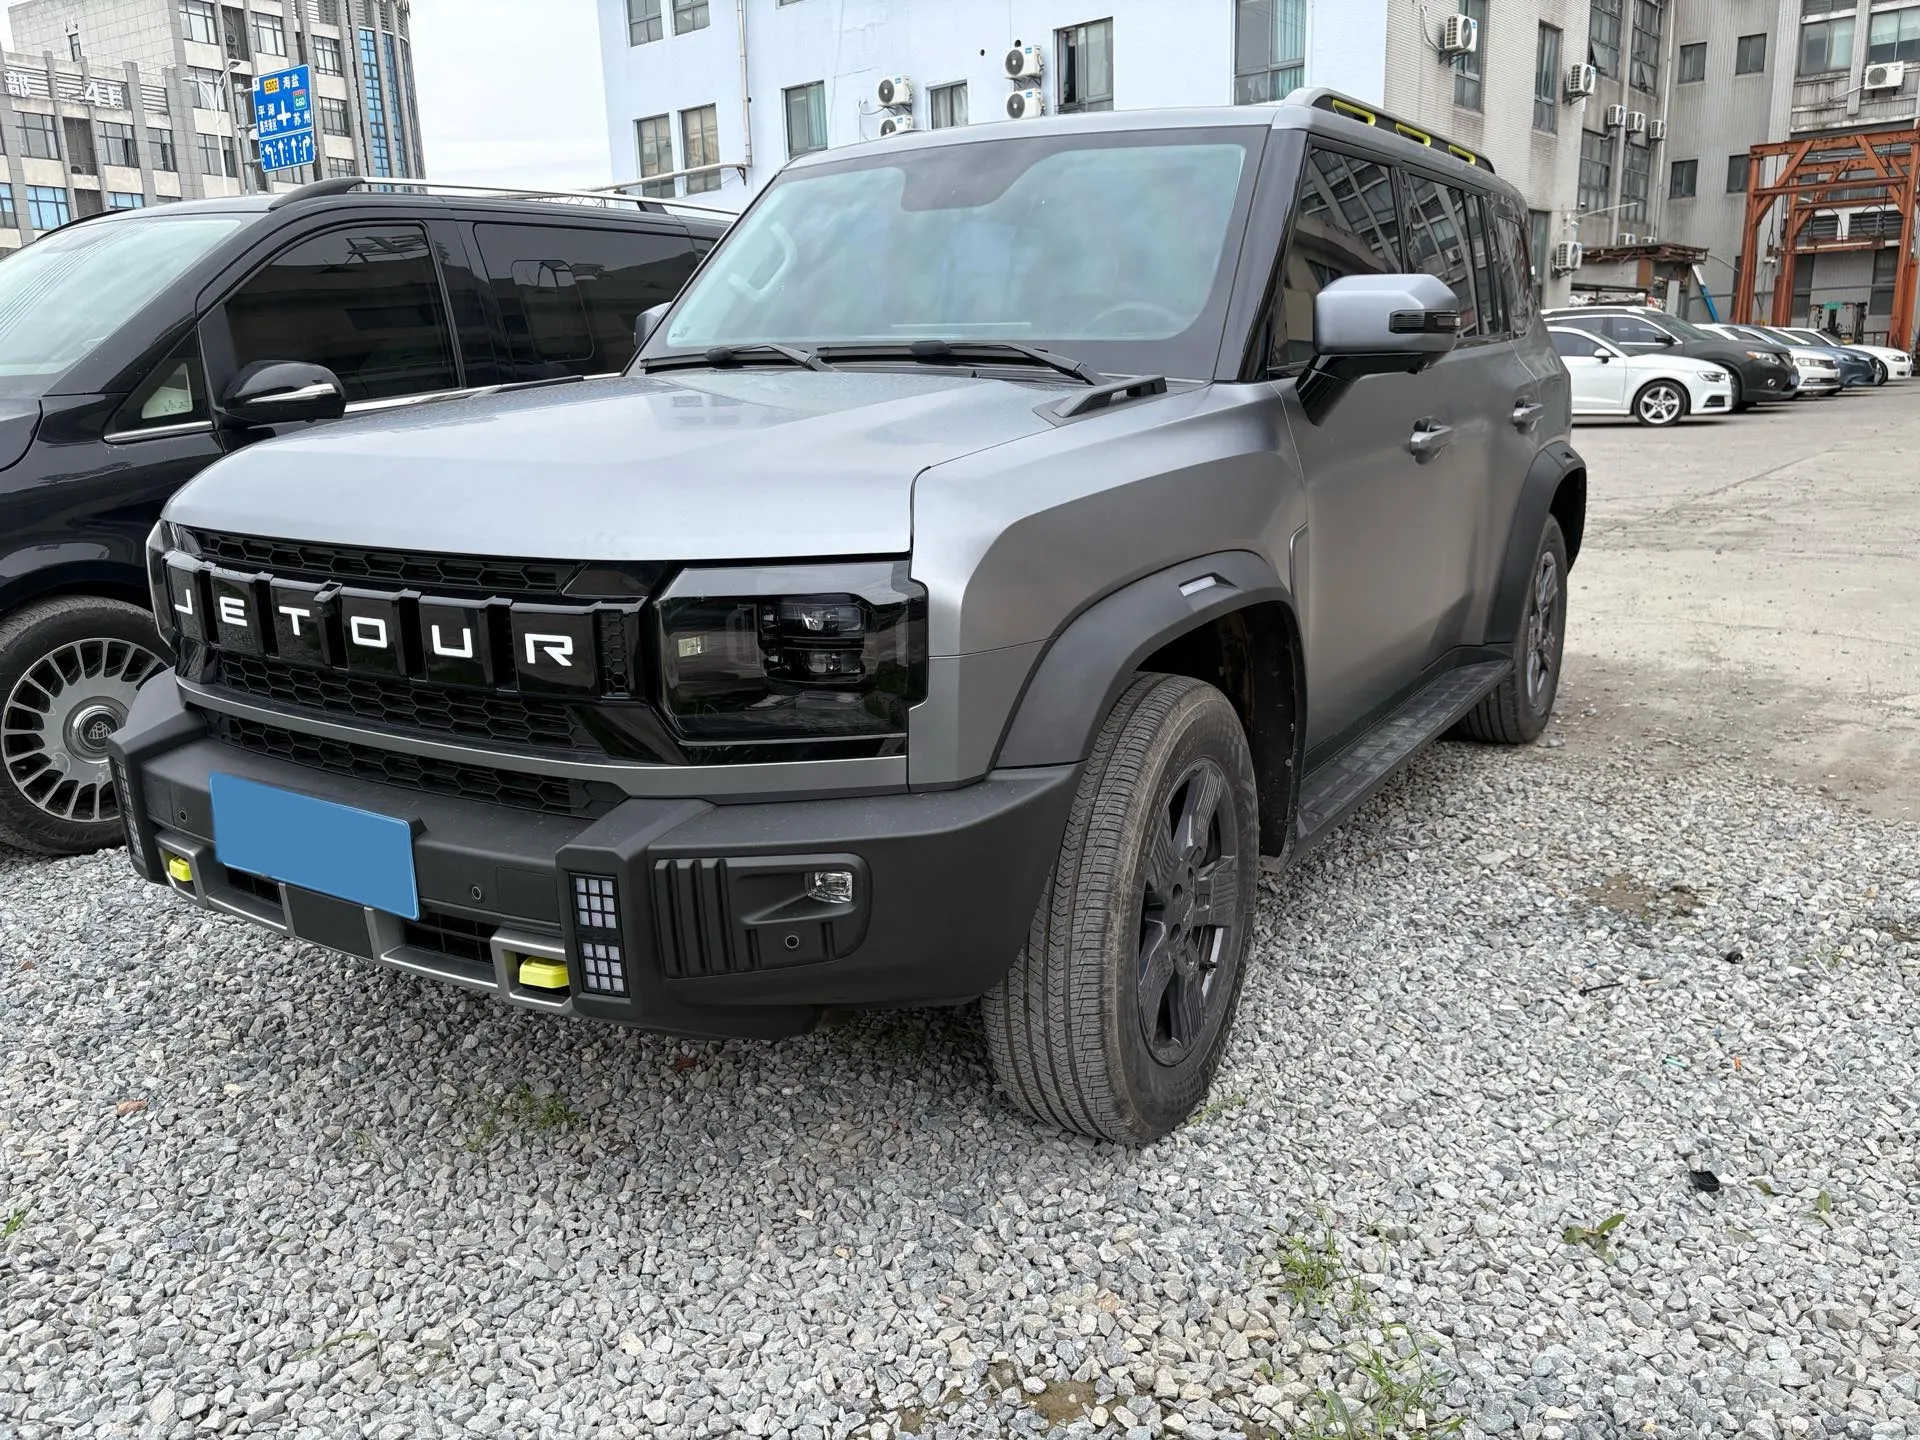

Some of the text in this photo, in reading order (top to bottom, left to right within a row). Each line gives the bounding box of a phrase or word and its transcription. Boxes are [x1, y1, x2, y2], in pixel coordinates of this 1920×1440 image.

[283, 74, 299, 89] 海盐
[296, 97, 305, 107] G60
[293, 110, 311, 126] 苏州
[174, 589, 574, 667] JETOUR
